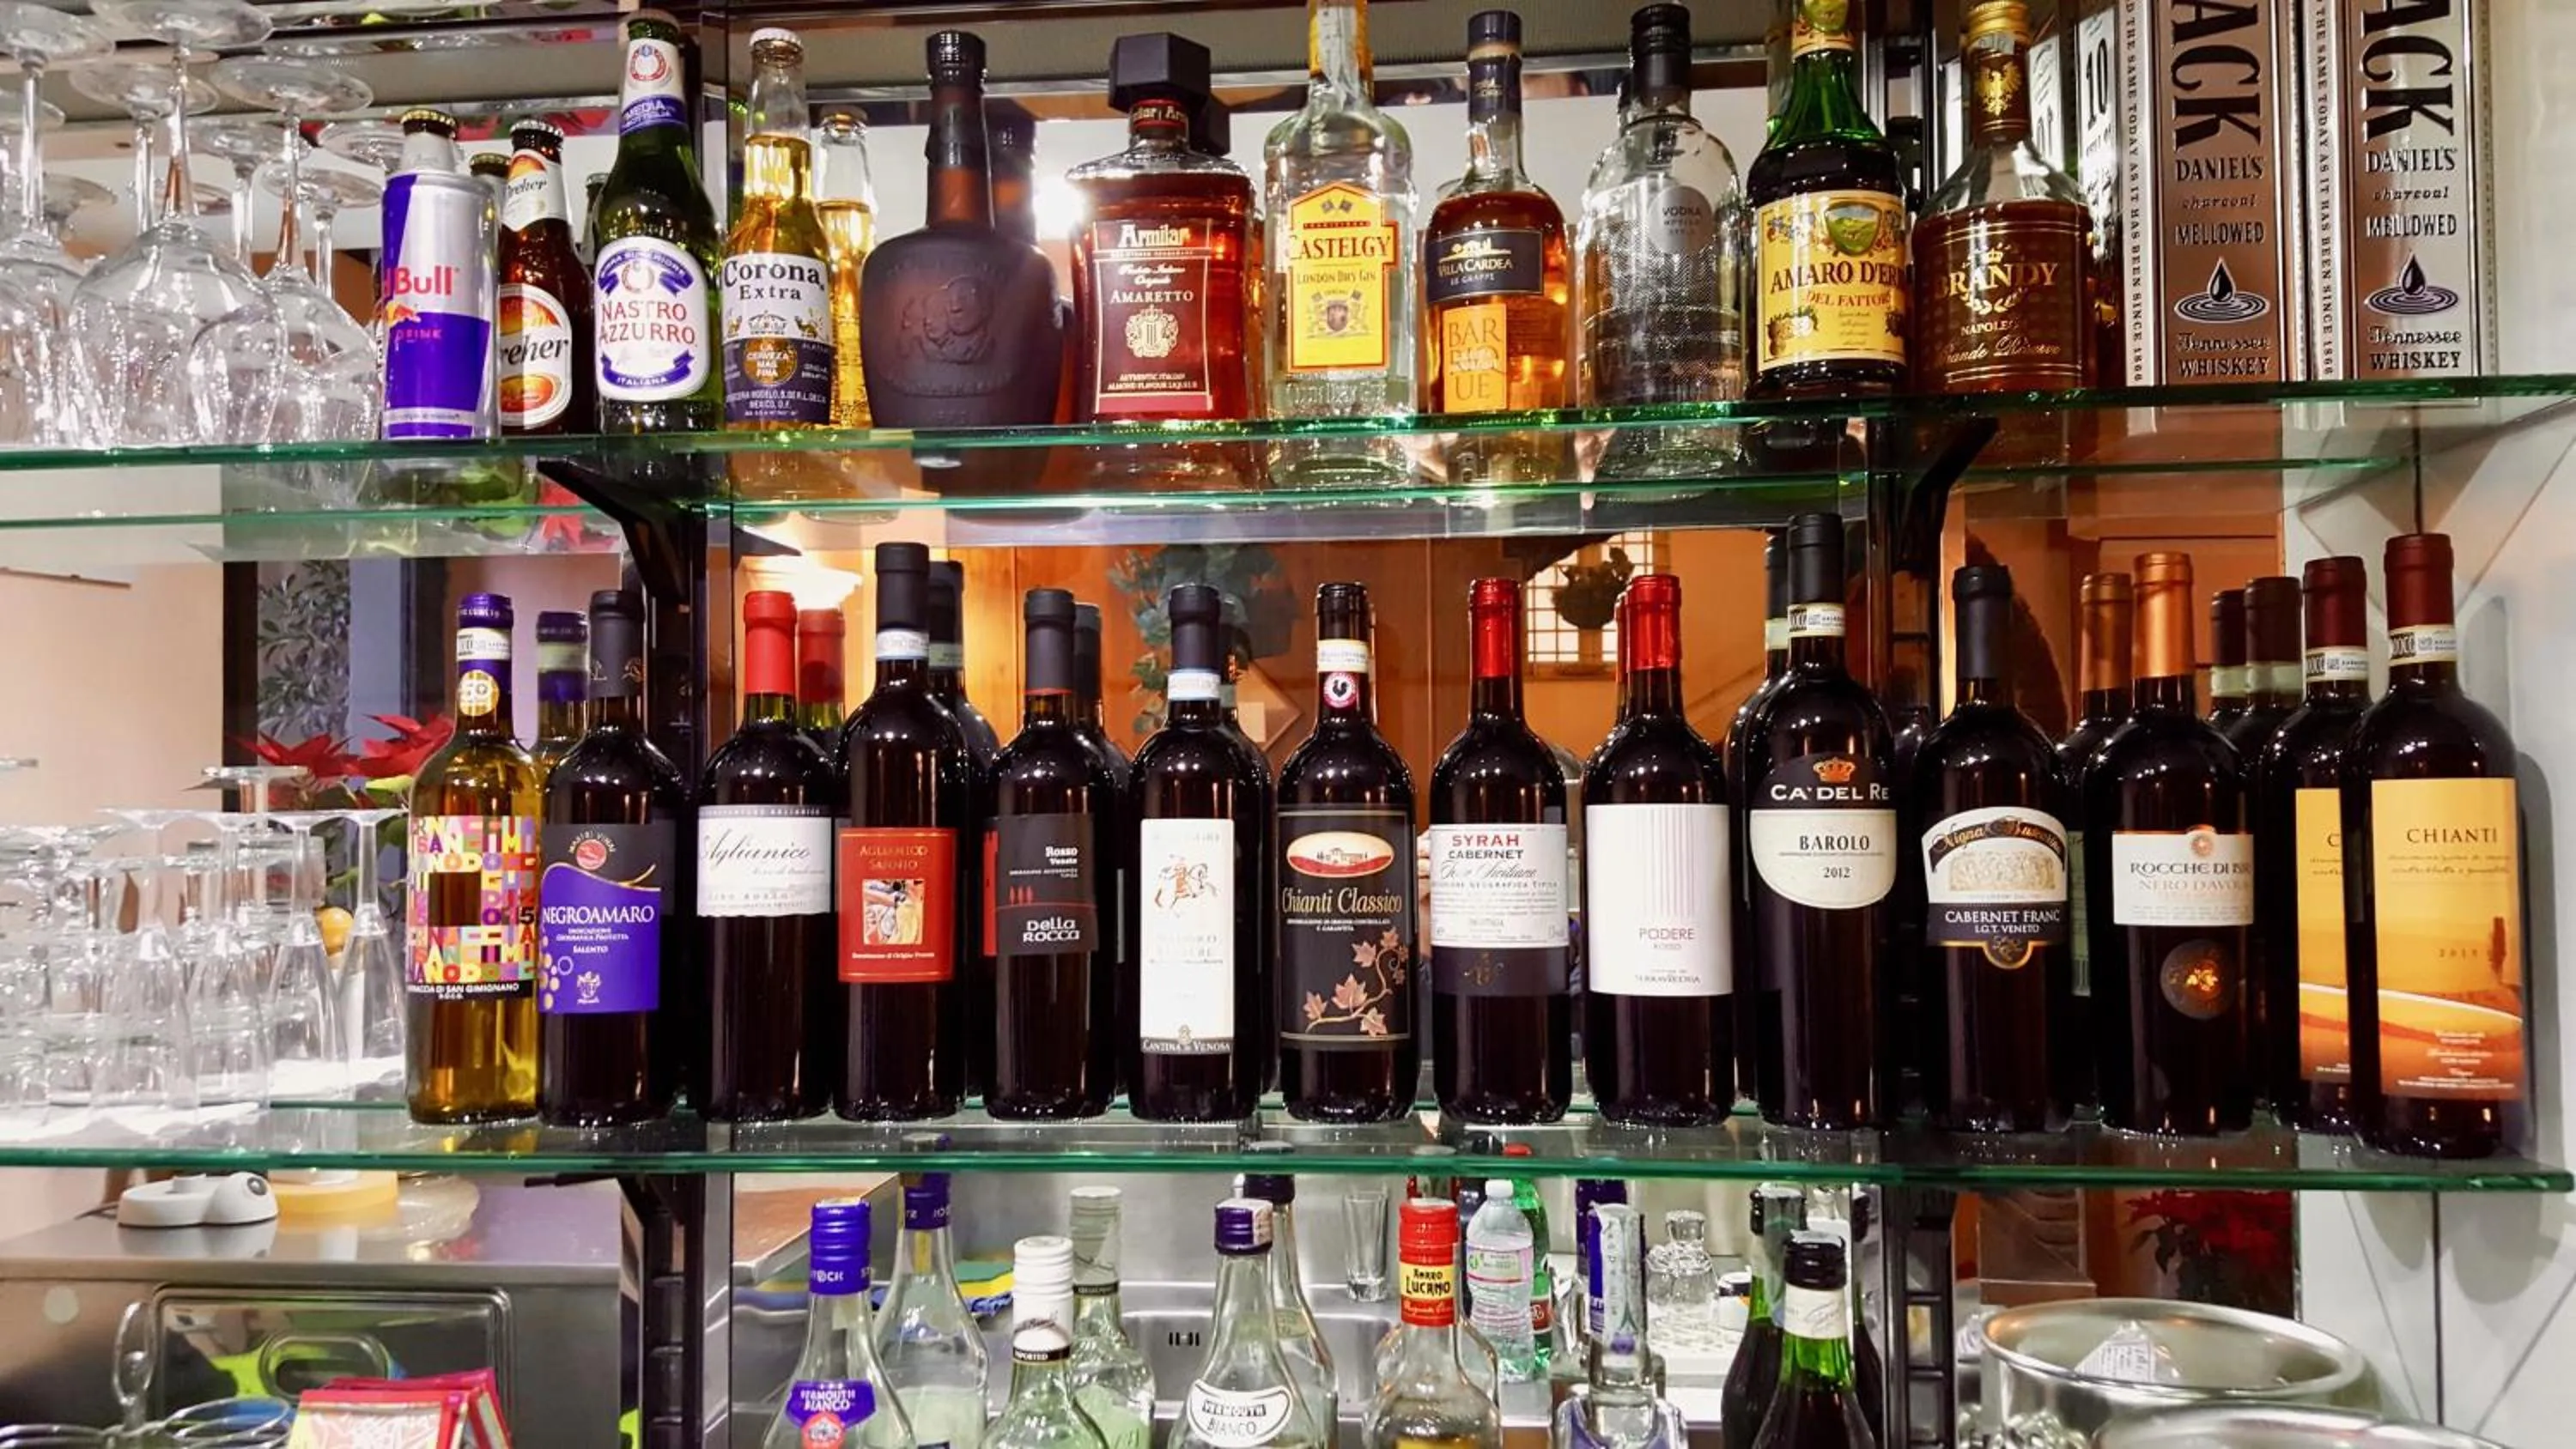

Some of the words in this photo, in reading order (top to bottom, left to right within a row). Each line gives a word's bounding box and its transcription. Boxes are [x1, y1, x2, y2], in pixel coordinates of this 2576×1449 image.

[2127, 56, 2137, 103] SAME
[2317, 49, 2327, 90] SAME
[2129, 104, 2138, 155] TODAY
[2318, 94, 2329, 147] TODAY
[2176, 155, 2263, 181] DANIEL'S
[2366, 148, 2457, 173] DANIEL'S
[2374, 186, 2449, 202] charcoal
[2175, 221, 2266, 246] MELLOWED
[2366, 215, 2458, 237] MELLOWED
[2131, 246, 2142, 288] BEEN
[2321, 238, 2332, 279] BEEN
[394, 264, 453, 296] Bull
[739, 285, 801, 300] Extra
[1111, 290, 1194, 304] AMARETTO
[602, 301, 687, 323] NASTRO
[2132, 293, 2142, 341] SINCE
[2323, 285, 2333, 334] SINCE
[600, 323, 696, 345] AZZURRO
[1448, 318, 1501, 347] BAR
[2369, 325, 2462, 344] Tennessee
[2178, 357, 2269, 378] WHISKEY
[2369, 351, 2461, 369] WHISKEY
[1455, 375, 1492, 400] UE
[1452, 834, 1519, 847] SYRAH
[1800, 835, 1870, 851] BAROLO
[2406, 828, 2499, 844] CHIANTI
[1449, 850, 1524, 859] CABERNET
[1823, 867, 1851, 878] 2012
[2130, 863, 2209, 877] ROCCHE
[1283, 888, 1334, 913] Chianti
[1337, 887, 1402, 913] Classico
[543, 906, 654, 925] NEGROAMARO
[1945, 911, 2020, 924] CABERNET
[2023, 910, 2061, 923] FRANC
[1639, 928, 1696, 941] PODERE
[2001, 924, 2040, 933] VENETO
